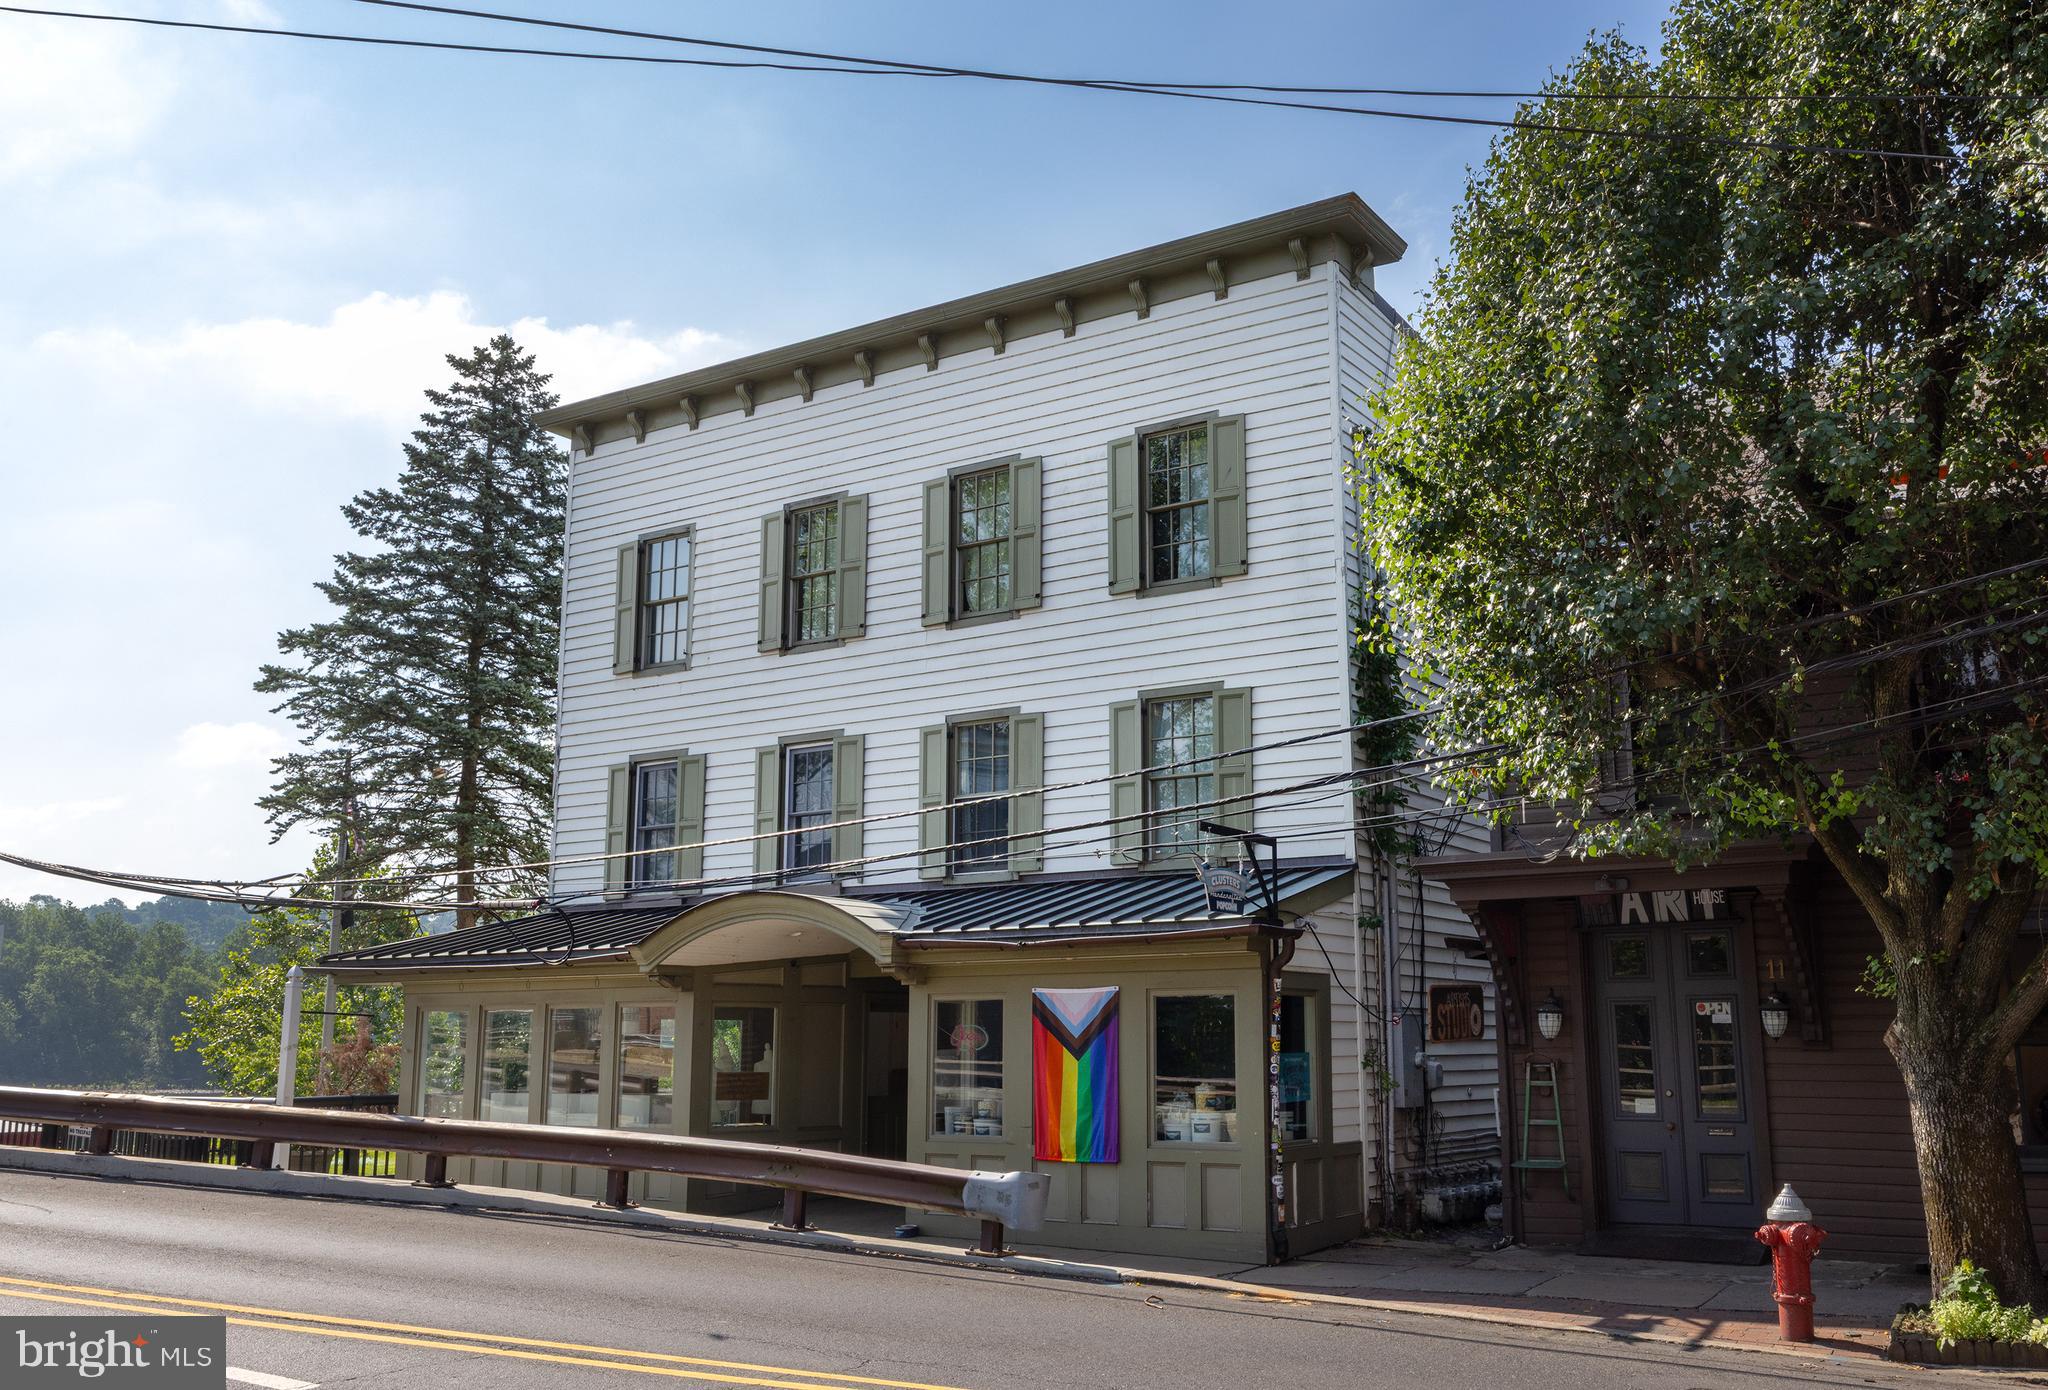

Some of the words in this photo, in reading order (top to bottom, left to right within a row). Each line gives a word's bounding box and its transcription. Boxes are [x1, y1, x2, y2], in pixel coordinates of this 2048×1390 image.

[1211, 875, 1241, 889] CLUSTERS
[1693, 890, 1726, 905] HOUSE
[1216, 900, 1238, 913] POPCORN
[1766, 959, 1785, 979] 11
[1696, 1002, 1731, 1016] OPEN
[1437, 1002, 1482, 1040] STUDIO
